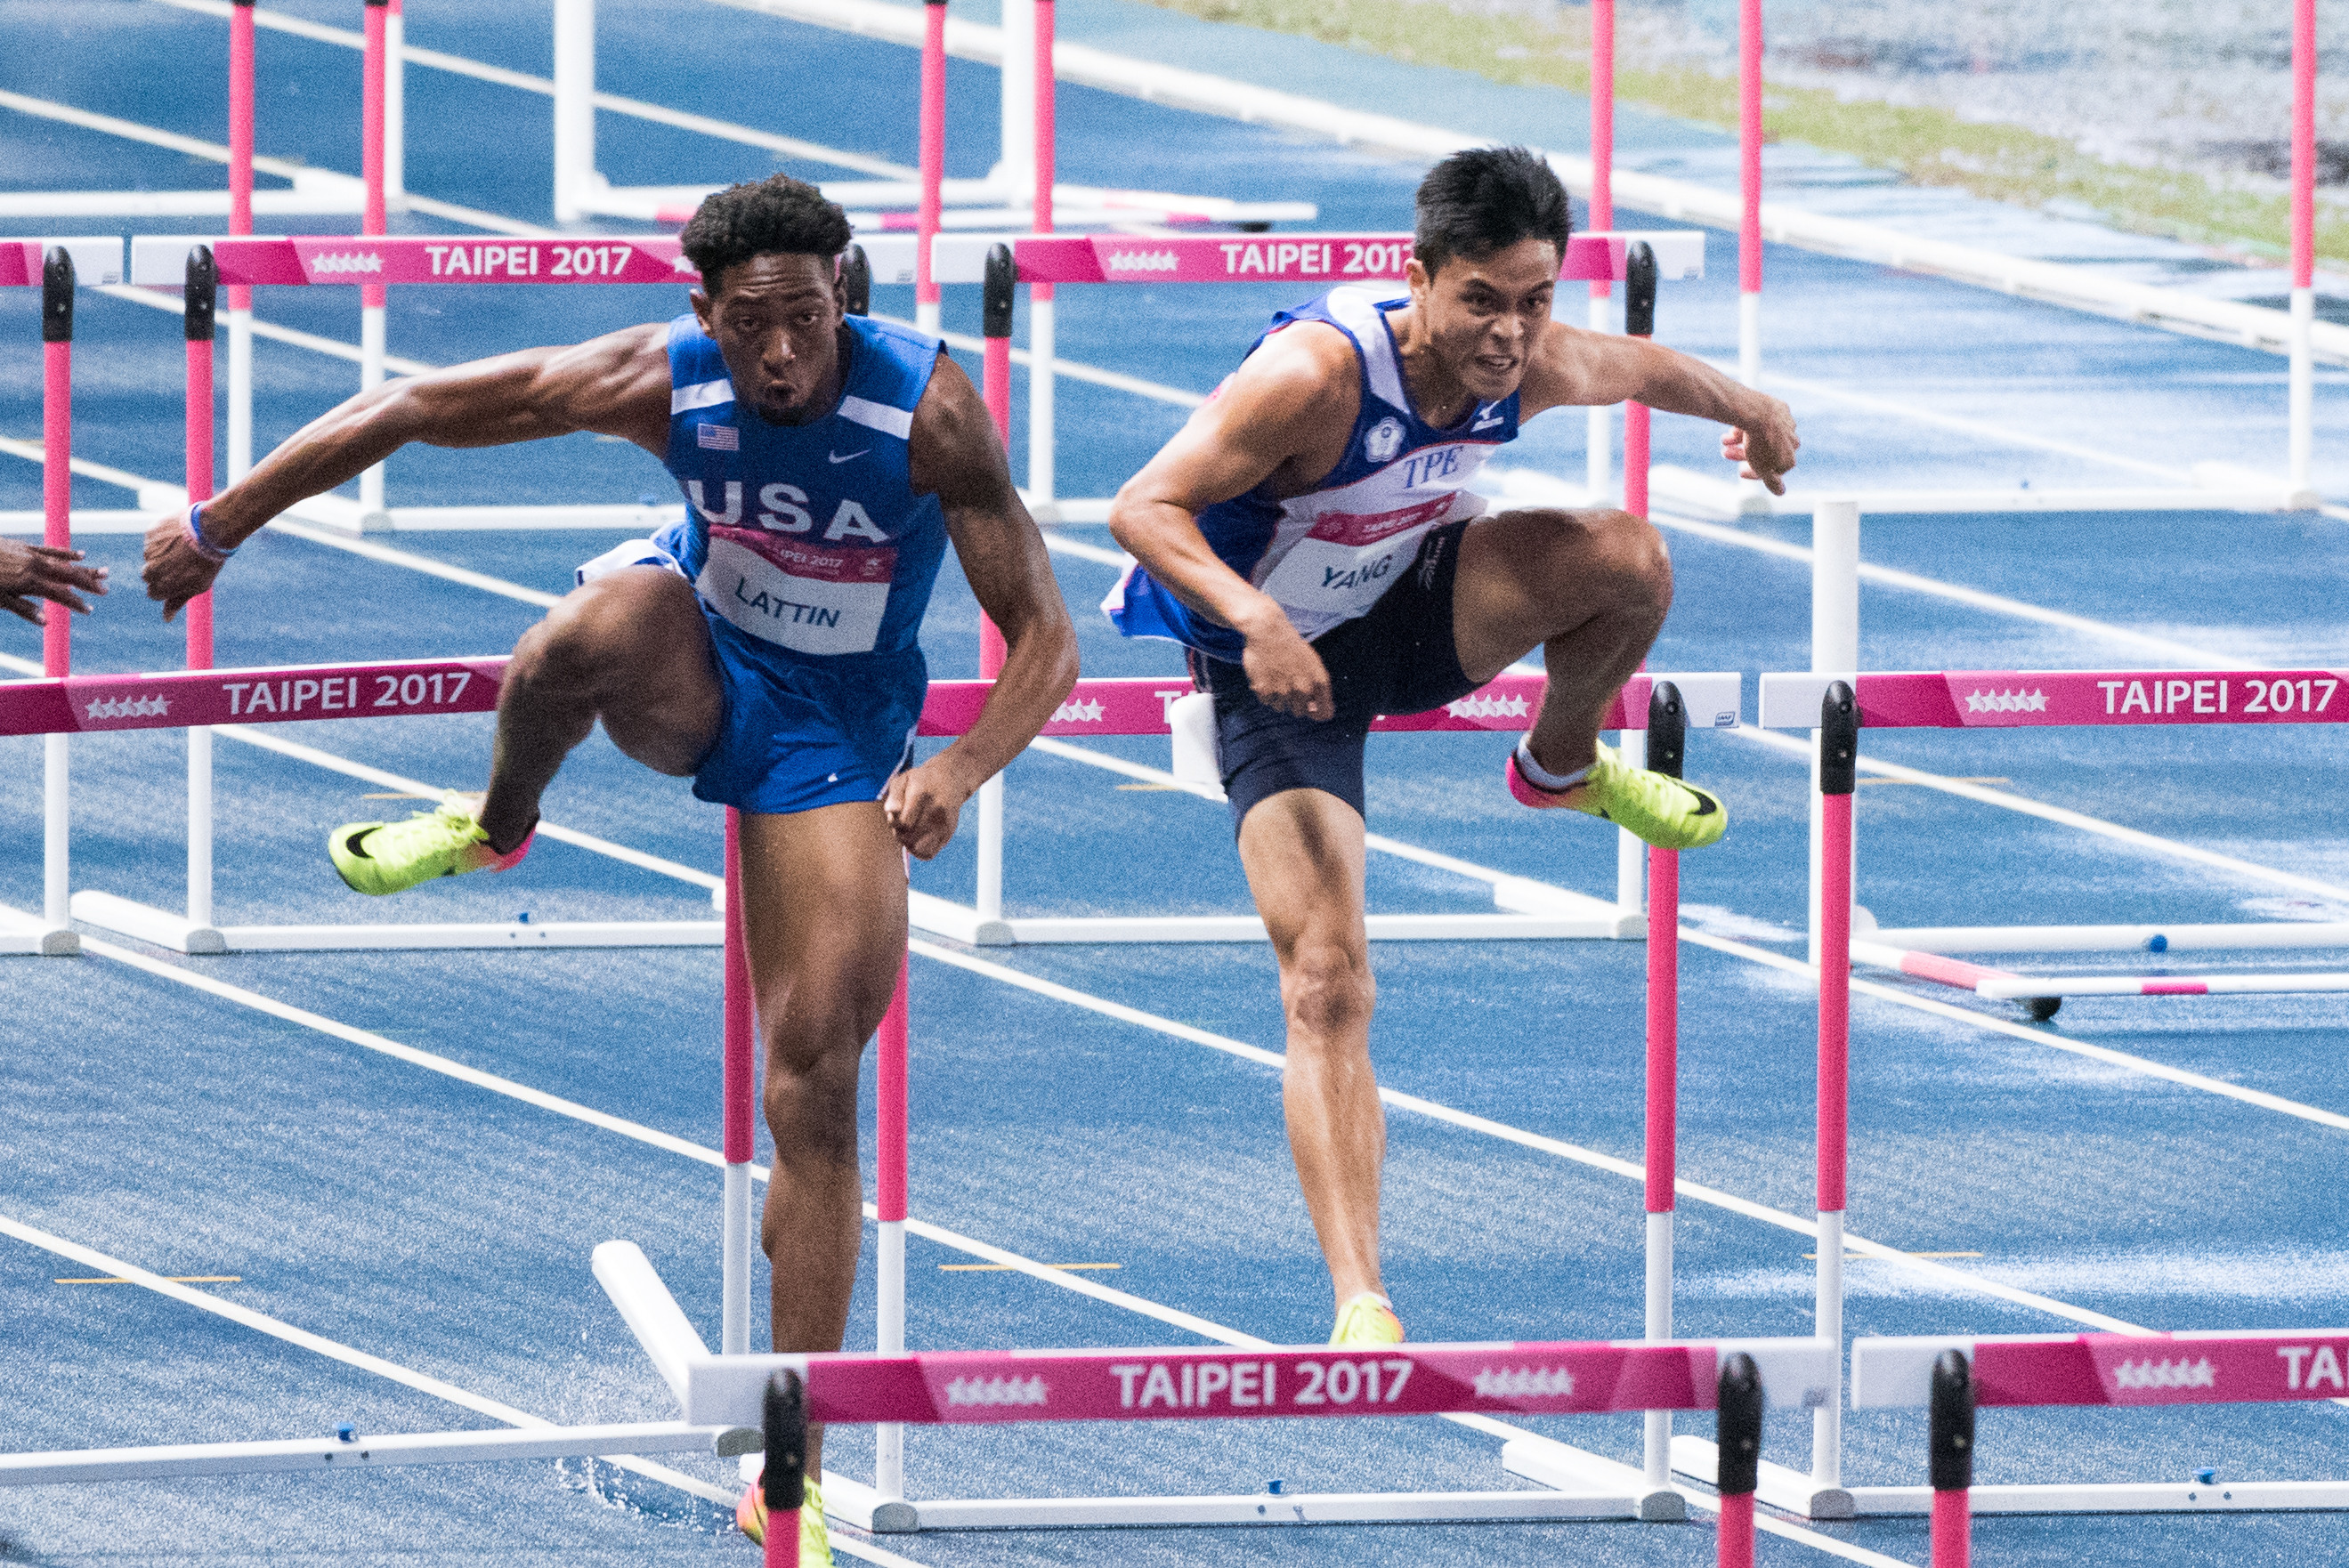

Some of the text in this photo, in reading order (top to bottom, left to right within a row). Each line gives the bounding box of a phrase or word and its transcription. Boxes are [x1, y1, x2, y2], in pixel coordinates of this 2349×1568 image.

[425, 247, 632, 276] TAIPEI 2017
[1220, 244, 1331, 273] TAIPEI
[1404, 446, 1462, 489] TPE
[687, 480, 890, 544] USA
[810, 555, 845, 568] 2017
[1321, 554, 1392, 590] YANG
[734, 577, 841, 628] LATTIN
[223, 671, 472, 715] TAIPEI 2017
[2097, 679, 2338, 714] TAIPEI 2017
[1109, 1359, 1413, 1408] TAIPEI 2017
[2278, 1346, 2349, 1390] TA
